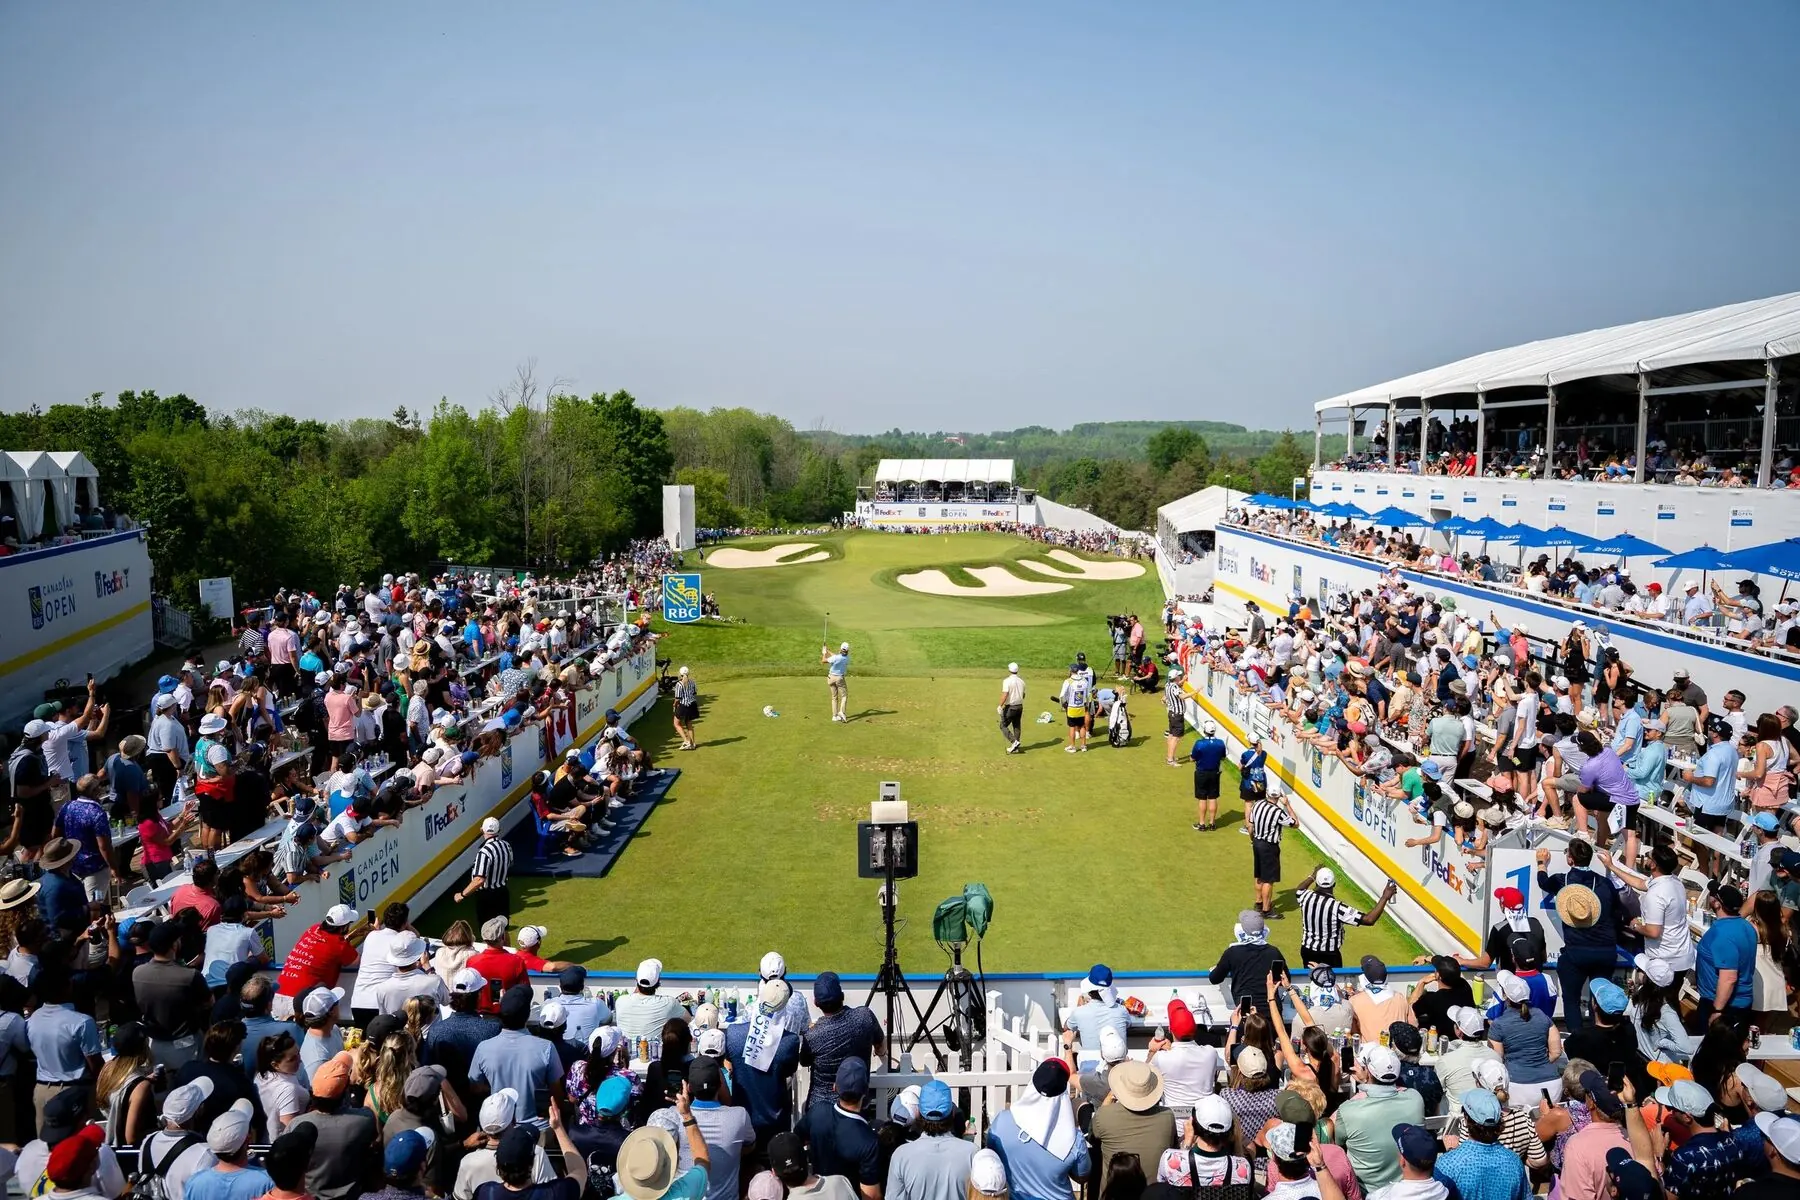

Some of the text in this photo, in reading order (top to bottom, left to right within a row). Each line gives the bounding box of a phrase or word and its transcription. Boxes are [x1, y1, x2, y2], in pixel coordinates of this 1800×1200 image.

[858, 505, 870, 514] 14
[102, 570, 123, 596] FedEx
[1223, 558, 1238, 574] OPEN
[43, 575, 74, 596] CANADIAN
[45, 593, 76, 622] OPEN
[668, 607, 698, 619] RBC
[434, 802, 459, 836] FedEx
[1365, 808, 1396, 847] OPEN
[357, 837, 399, 875] CANADIAN
[1432, 850, 1462, 895] FedEx
[358, 853, 400, 902] OPEN
[745, 1015, 764, 1057] OPEN
[752, 1020, 769, 1060] CANADIAN
